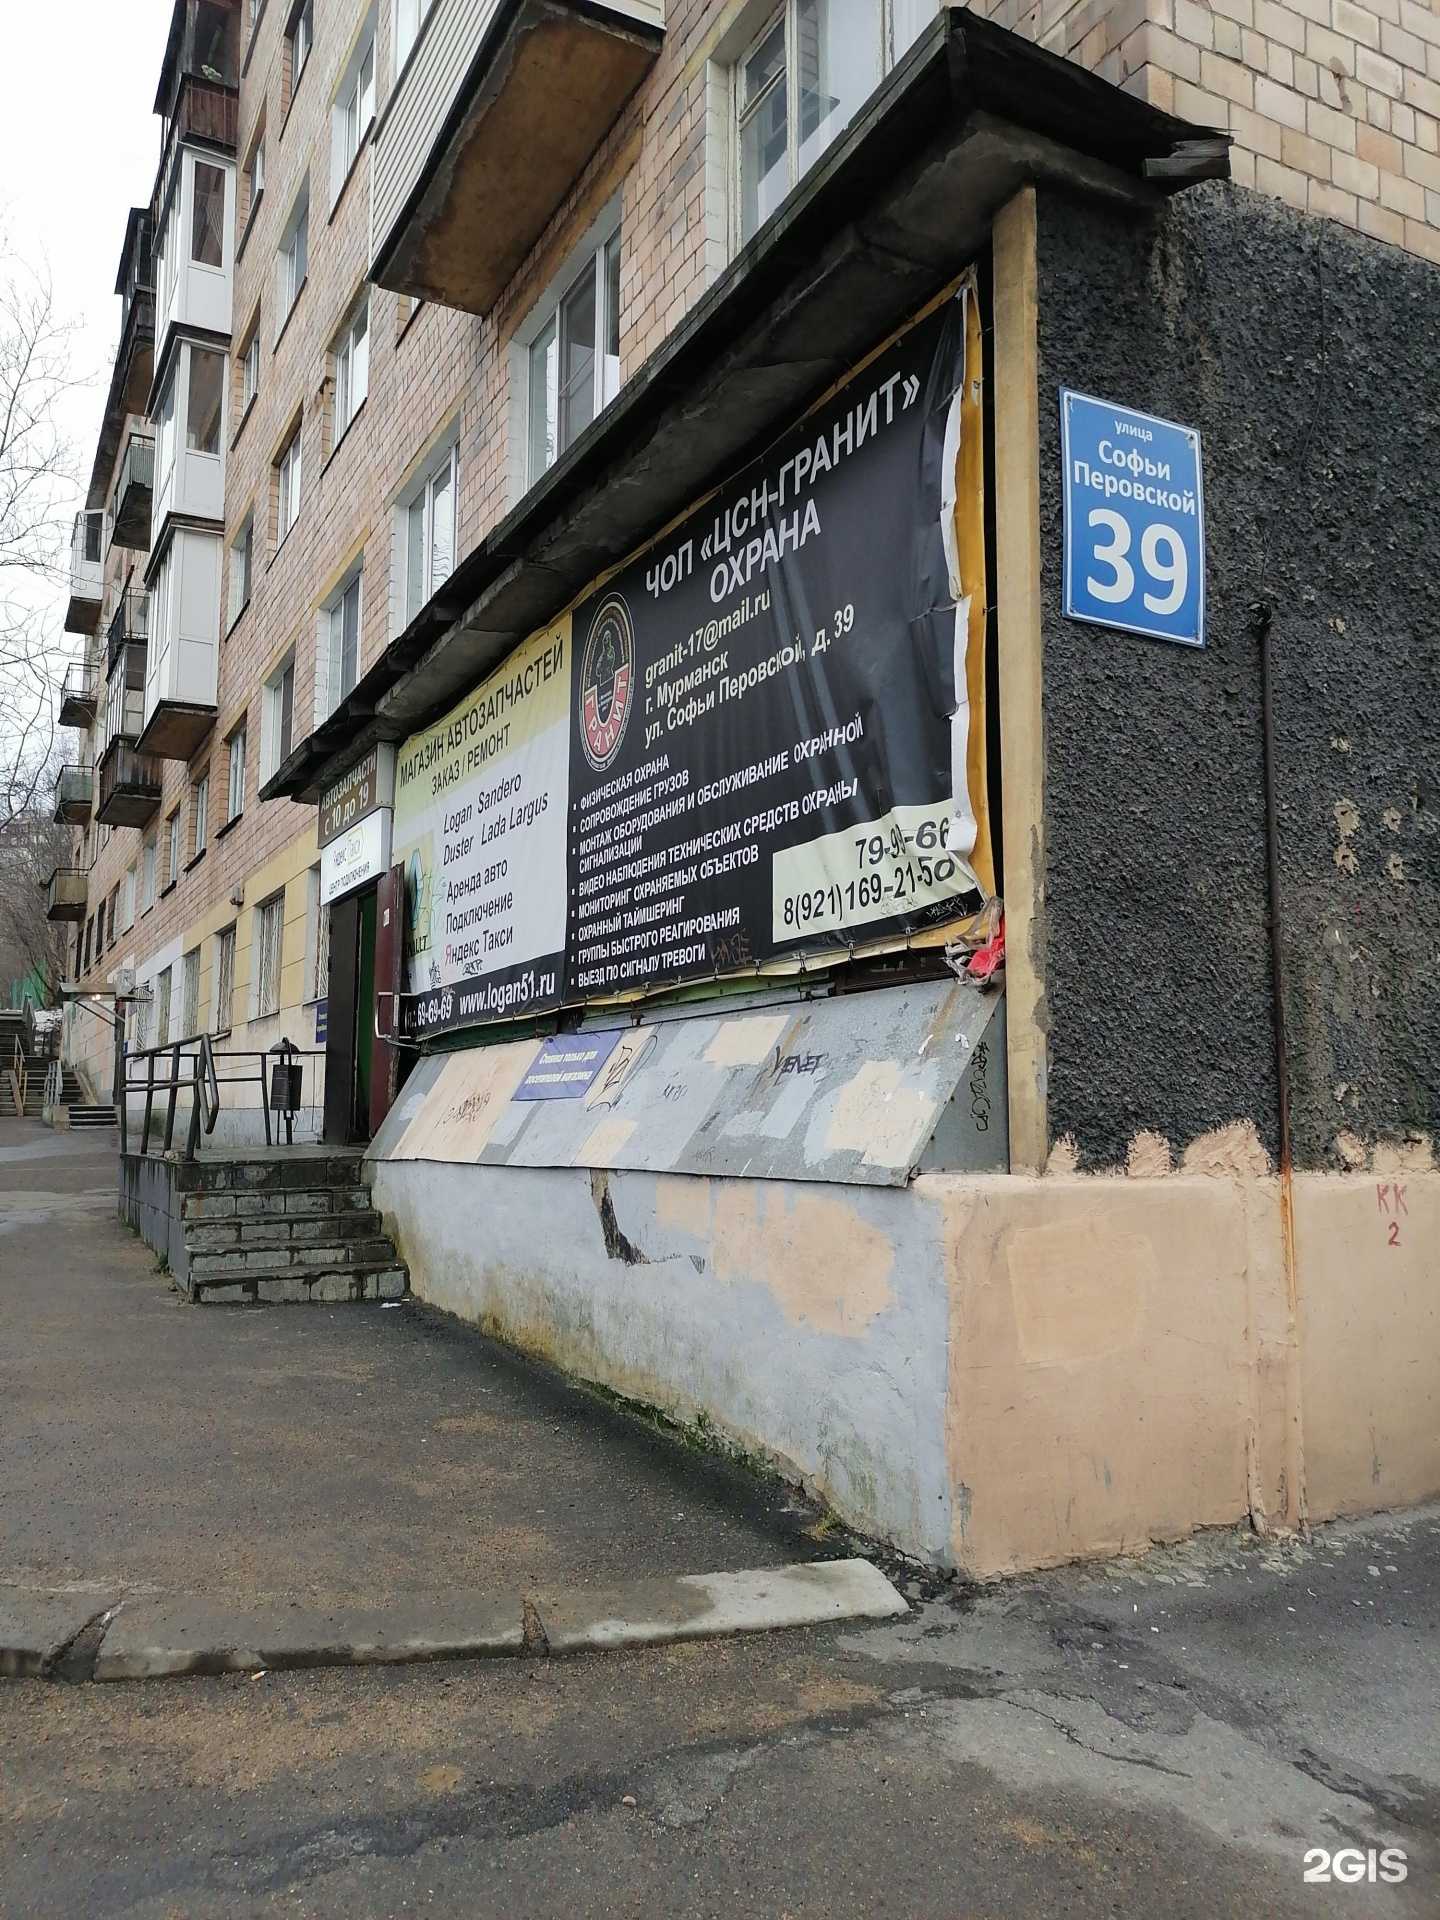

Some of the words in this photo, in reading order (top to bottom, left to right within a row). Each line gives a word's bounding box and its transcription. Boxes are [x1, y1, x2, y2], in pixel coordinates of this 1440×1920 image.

[1098, 440, 1170, 480] Софьи
[1115, 420, 1153, 442] улица
[646, 539, 693, 599] ЧОП
[700, 371, 920, 561] «ЦСН-ГРАНИТ»
[1074, 460, 1196, 515] Перовской
[710, 498, 821, 603] ОХРАНА
[1087, 508, 1188, 615] 39
[645, 590, 770, 689] granit-17@mail.ru
[645, 723, 664, 749] ул.
[667, 690, 714, 731] Софьи
[719, 633, 805, 704] Перовской,
[811, 628, 830, 657] д.
[834, 604, 854, 638] 39
[646, 697, 653, 715] г.
[657, 651, 728, 708] Мурманск
[400, 733, 445, 788] МАГАЗИН
[447, 632, 563, 753] АВТОЗАПЧАСТЕЙ
[585, 676, 628, 752] ГРАНИТ
[321, 751, 377, 811] АВТОЗАПЧАСТИ
[431, 758, 460, 796] ЗАКАЗ
[467, 722, 511, 773] РЕМОНТ
[579, 826, 612, 857] МОНТАЖ
[613, 797, 685, 841] ОБОРУДОВАНИЯ
[687, 792, 695, 810] И
[697, 750, 789, 805] ОБСЛУЖИВАНИЕ
[793, 712, 864, 763] ОХРАННОЙ
[580, 772, 633, 811] ФИЗИЧЕСКАЯ
[634, 754, 670, 784] ОХРАНА
[331, 804, 341, 830] 10
[343, 798, 355, 827] ДО
[358, 782, 369, 810] 19
[443, 803, 472, 835] Logan
[477, 774, 522, 814] Sandero
[443, 835, 474, 866] Duster
[481, 814, 506, 846] Lada
[509, 792, 548, 830] Largus
[580, 786, 652, 833] СОПРОВОЖДЕНИЕ
[653, 769, 689, 799] ГРУЗОВ
[578, 874, 604, 897] ВИДЕО
[605, 850, 666, 887] НАБЛЮДЕНИЯ
[667, 821, 742, 864] ТЕХНИЧЕСКИХ
[743, 800, 799, 836] СРЕДСТВ
[801, 778, 858, 815] ОХРАНЫ
[579, 835, 643, 874] СИГНАЛИЗАЦИИ
[446, 870, 481, 903] Аренда
[484, 859, 508, 886] авто
[578, 887, 632, 920] МОНИТОРИНГ
[633, 864, 698, 901] ОХРАНЯЕМЫХ
[700, 844, 759, 880] ОБЪЕКТОВ
[446, 891, 513, 935] Подключение
[578, 910, 622, 942] ОХРАННЫЙ
[623, 896, 685, 927] ТАЙМШЕРИНГ
[578, 941, 610, 965] ГРУППЫ
[611, 929, 658, 956] БЫСТРОГО
[659, 907, 740, 944] РЕАГИРОВАНИЯ
[445, 938, 480, 967] Яндекс
[483, 925, 513, 953] Такси
[578, 966, 605, 988] ВЫЕЗД
[606, 963, 619, 981] ПО
[620, 954, 660, 979] СИГНАЛУ
[661, 943, 706, 970] ТРЕВОГИ
[459, 969, 555, 1016] www.logan51.ru
[1388, 1221, 1402, 1247] 2
